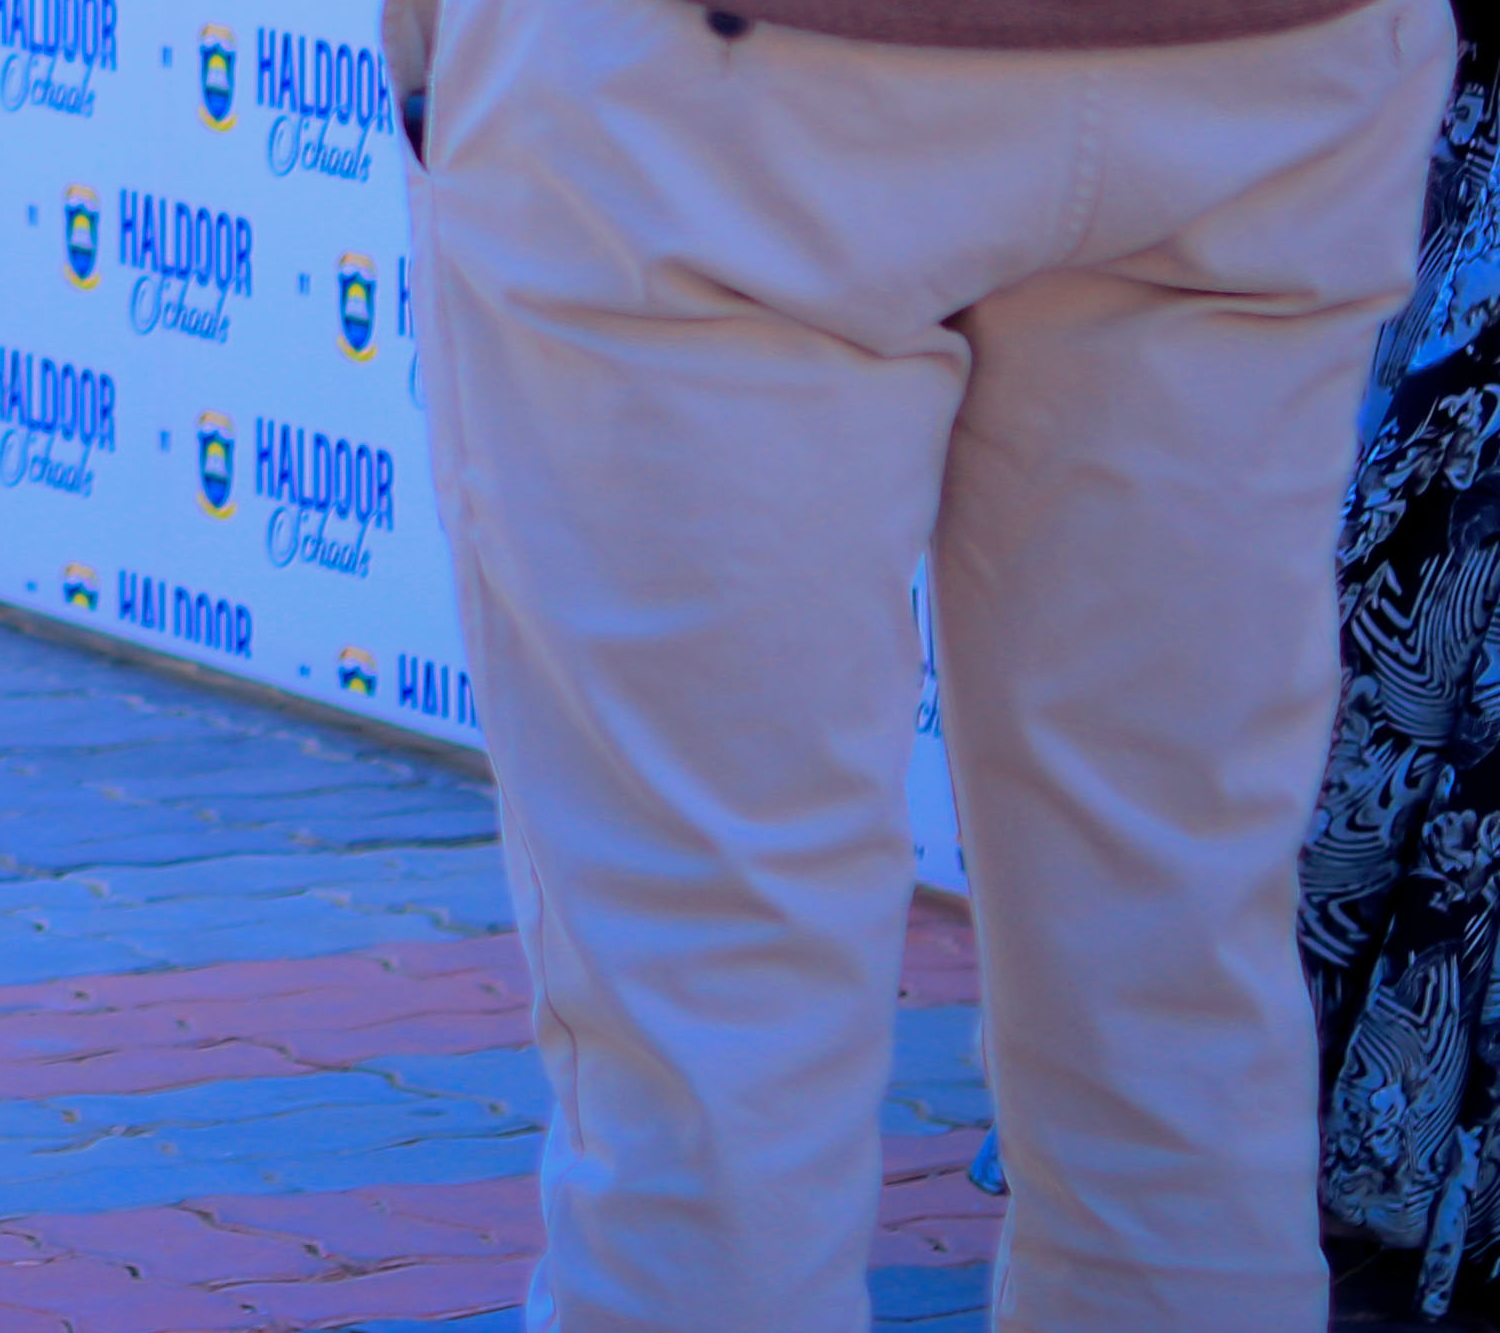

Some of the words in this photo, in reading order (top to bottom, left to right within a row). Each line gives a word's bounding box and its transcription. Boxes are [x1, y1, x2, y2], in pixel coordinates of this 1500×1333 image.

[0, 49, 96, 120] Schools
[268, 107, 372, 183] Schools
[119, 188, 253, 299] HALDOOR
[129, 269, 231, 345] Schools
[255, 416, 394, 532] HALDOOR
[268, 502, 372, 579] Schools
